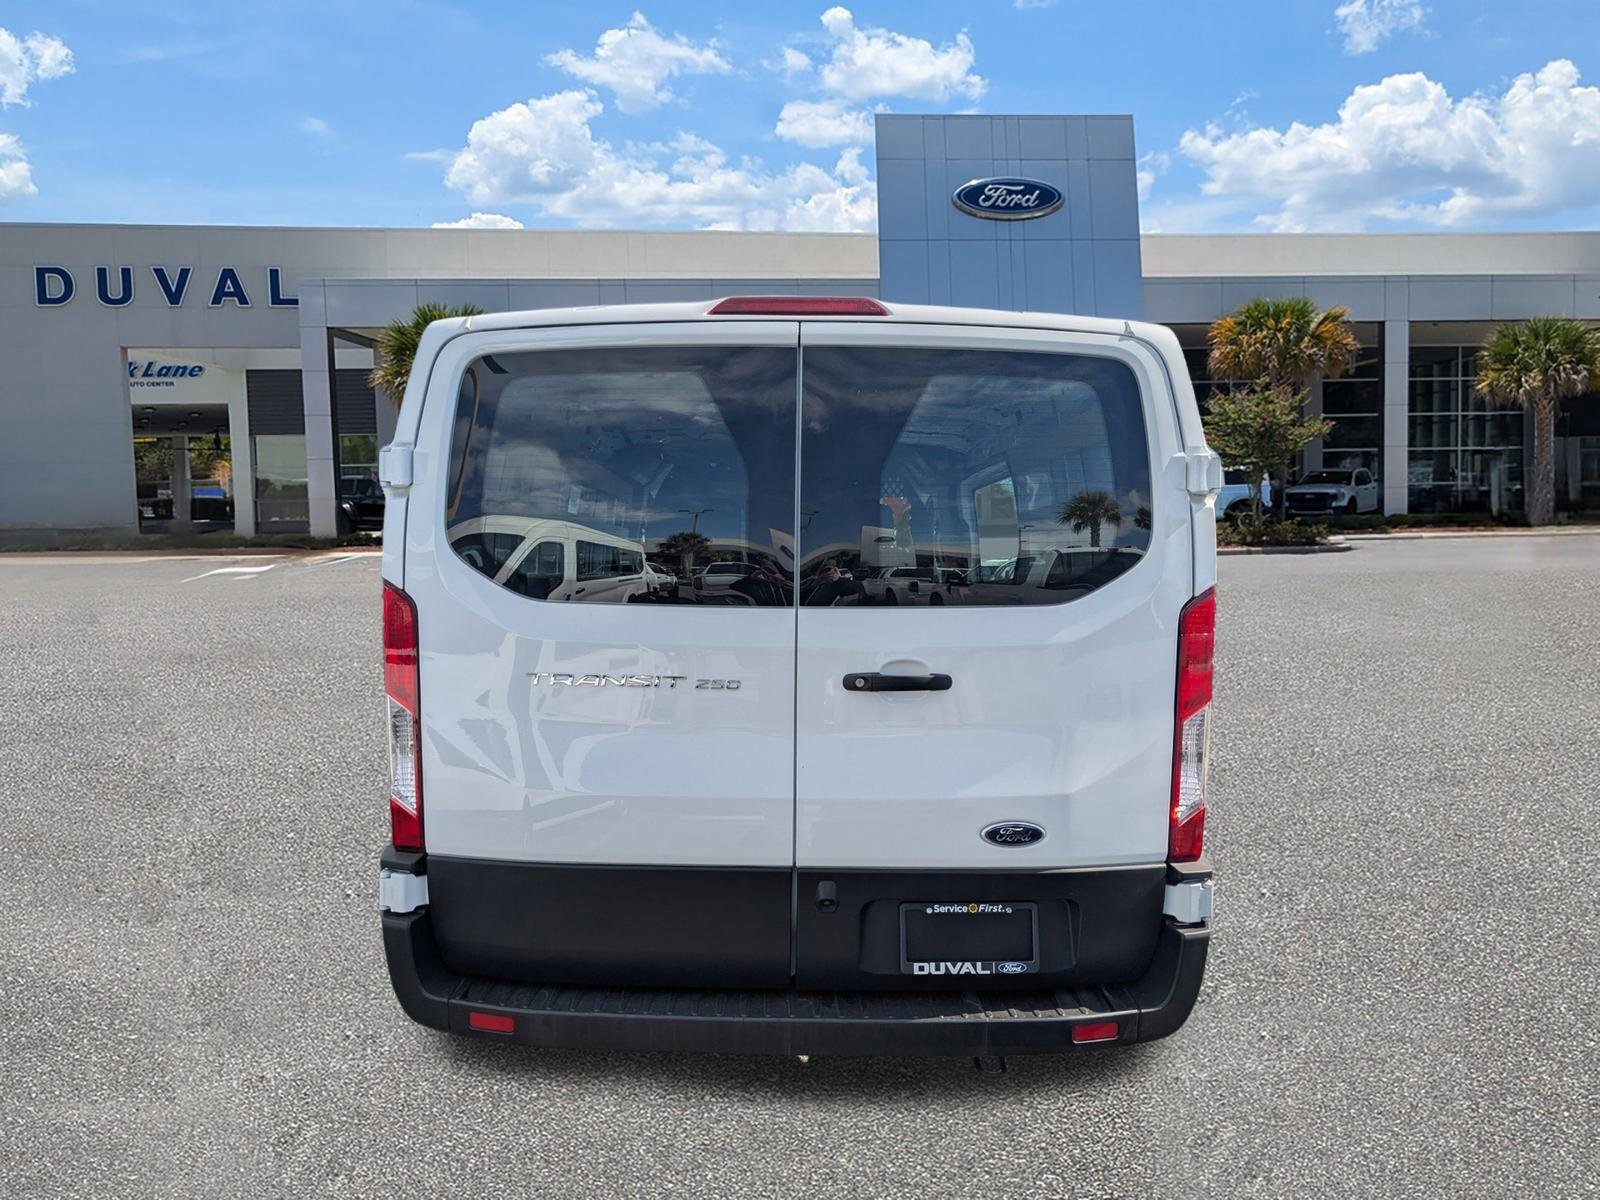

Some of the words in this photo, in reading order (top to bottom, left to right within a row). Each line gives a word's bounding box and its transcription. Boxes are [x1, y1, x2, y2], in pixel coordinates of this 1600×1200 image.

[979, 184, 1040, 207] Ford
[34, 265, 299, 307] DUVAL
[141, 361, 205, 378] Lane
[526, 672, 687, 689] TRANSIT
[695, 679, 742, 690] 250
[996, 827, 1034, 842] Ford
[934, 904, 968, 914] Service
[913, 962, 991, 975] DUVAL
